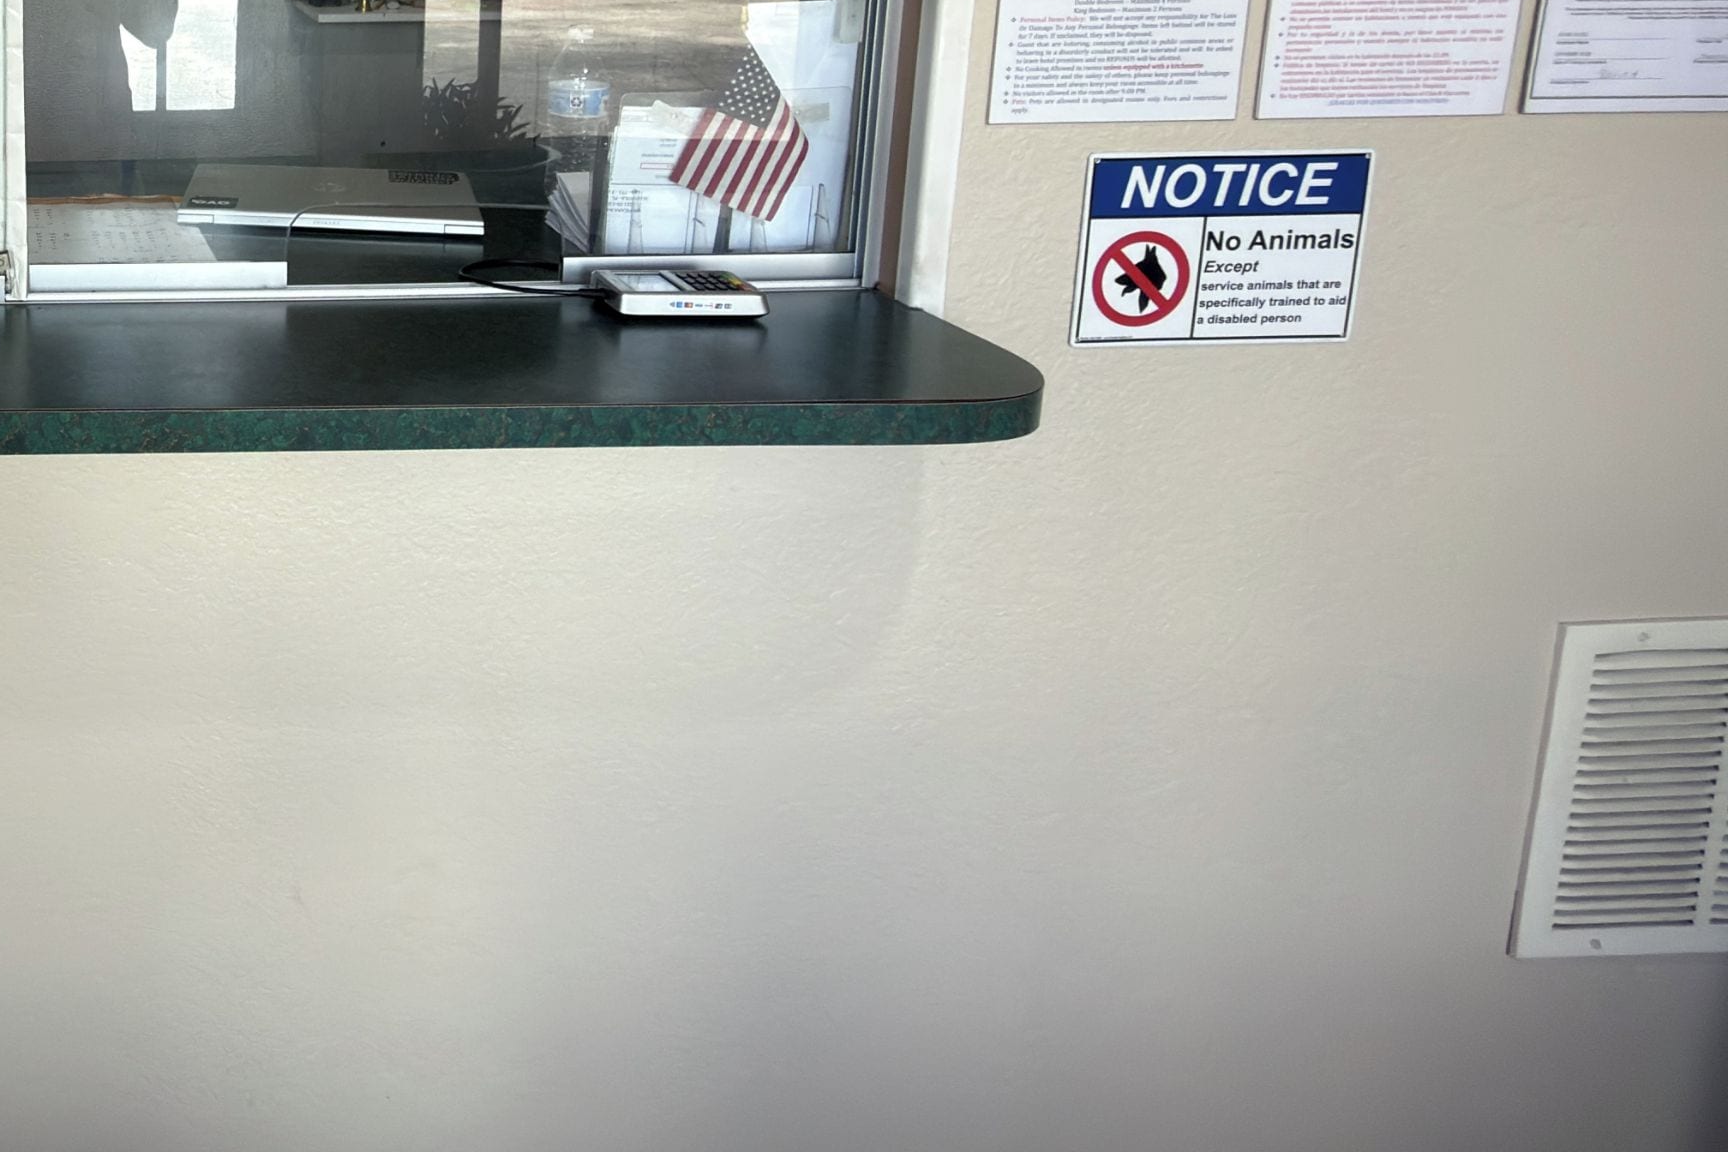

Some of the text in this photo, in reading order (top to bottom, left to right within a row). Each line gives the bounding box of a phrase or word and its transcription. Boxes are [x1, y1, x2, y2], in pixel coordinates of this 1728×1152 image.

[1120, 161, 1339, 209] NOTICE
[1206, 229, 1355, 251] No Animals
[1204, 260, 1259, 275] Except
[1201, 279, 1342, 291] service animals that are
[1199, 295, 1347, 309] specifically trained to aid
[1196, 313, 1302, 325] a disabled person
